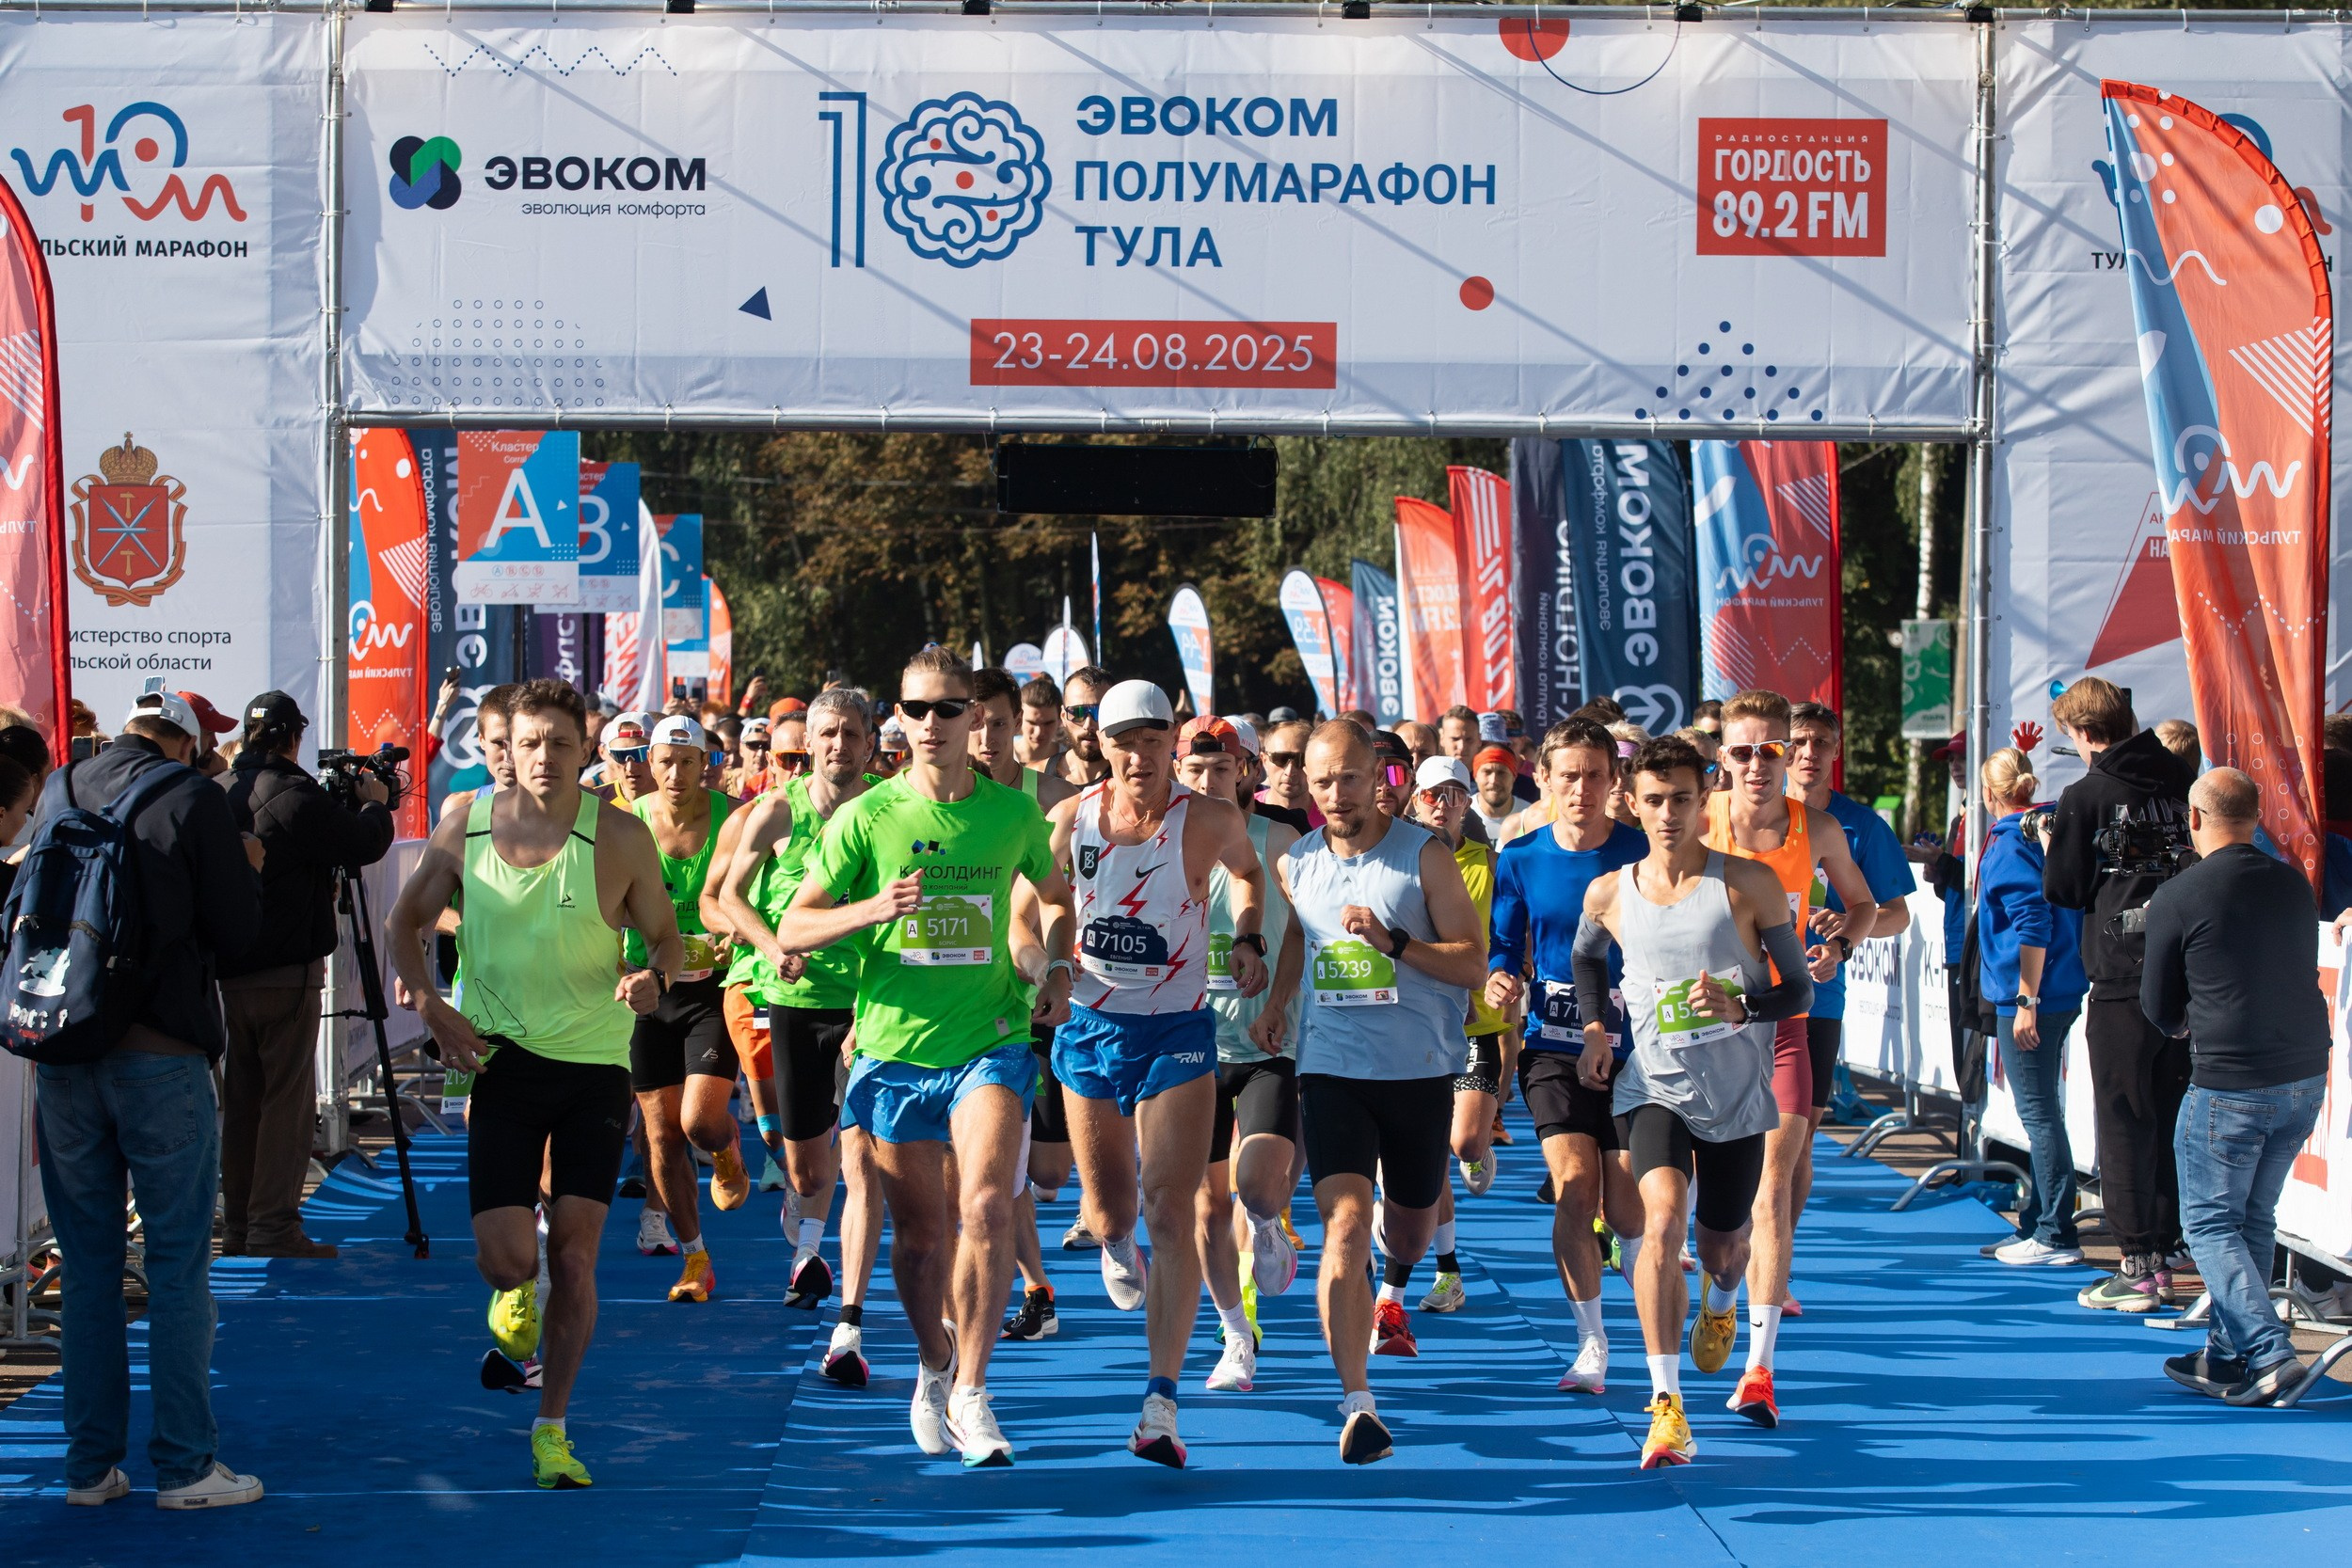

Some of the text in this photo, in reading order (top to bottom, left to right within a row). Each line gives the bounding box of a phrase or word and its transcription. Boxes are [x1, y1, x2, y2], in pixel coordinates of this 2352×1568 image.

[1076, 95, 1337, 137] ЭВОКОМ
[1715, 135, 1868, 144] РАДИОСТАНЦИЯ
[485, 156, 706, 192] ЭВОКОМ
[1713, 148, 1871, 182] ГОРДОСТЬ
[1074, 160, 1496, 207] ПОЛУМАРАФОН
[522, 201, 706, 219] эволюция комфорта
[1712, 190, 1868, 239] 89.2 FM
[135, 239, 248, 259] МАРАФОН
[1074, 226, 1222, 268] ТУЛА
[992, 331, 1314, 372] 23-24.08.2025
[491, 440, 539, 452] Кластер
[484, 467, 552, 548] A
[69, 629, 231, 648] истерство спорта
[136, 654, 212, 670] области
[251, 707, 266, 719] CAT
[908, 917, 968, 937] A 5171
[1088, 931, 1147, 954] A 7105
[1328, 959, 1372, 979] 5239
[1563, 1001, 1581, 1020] 71
